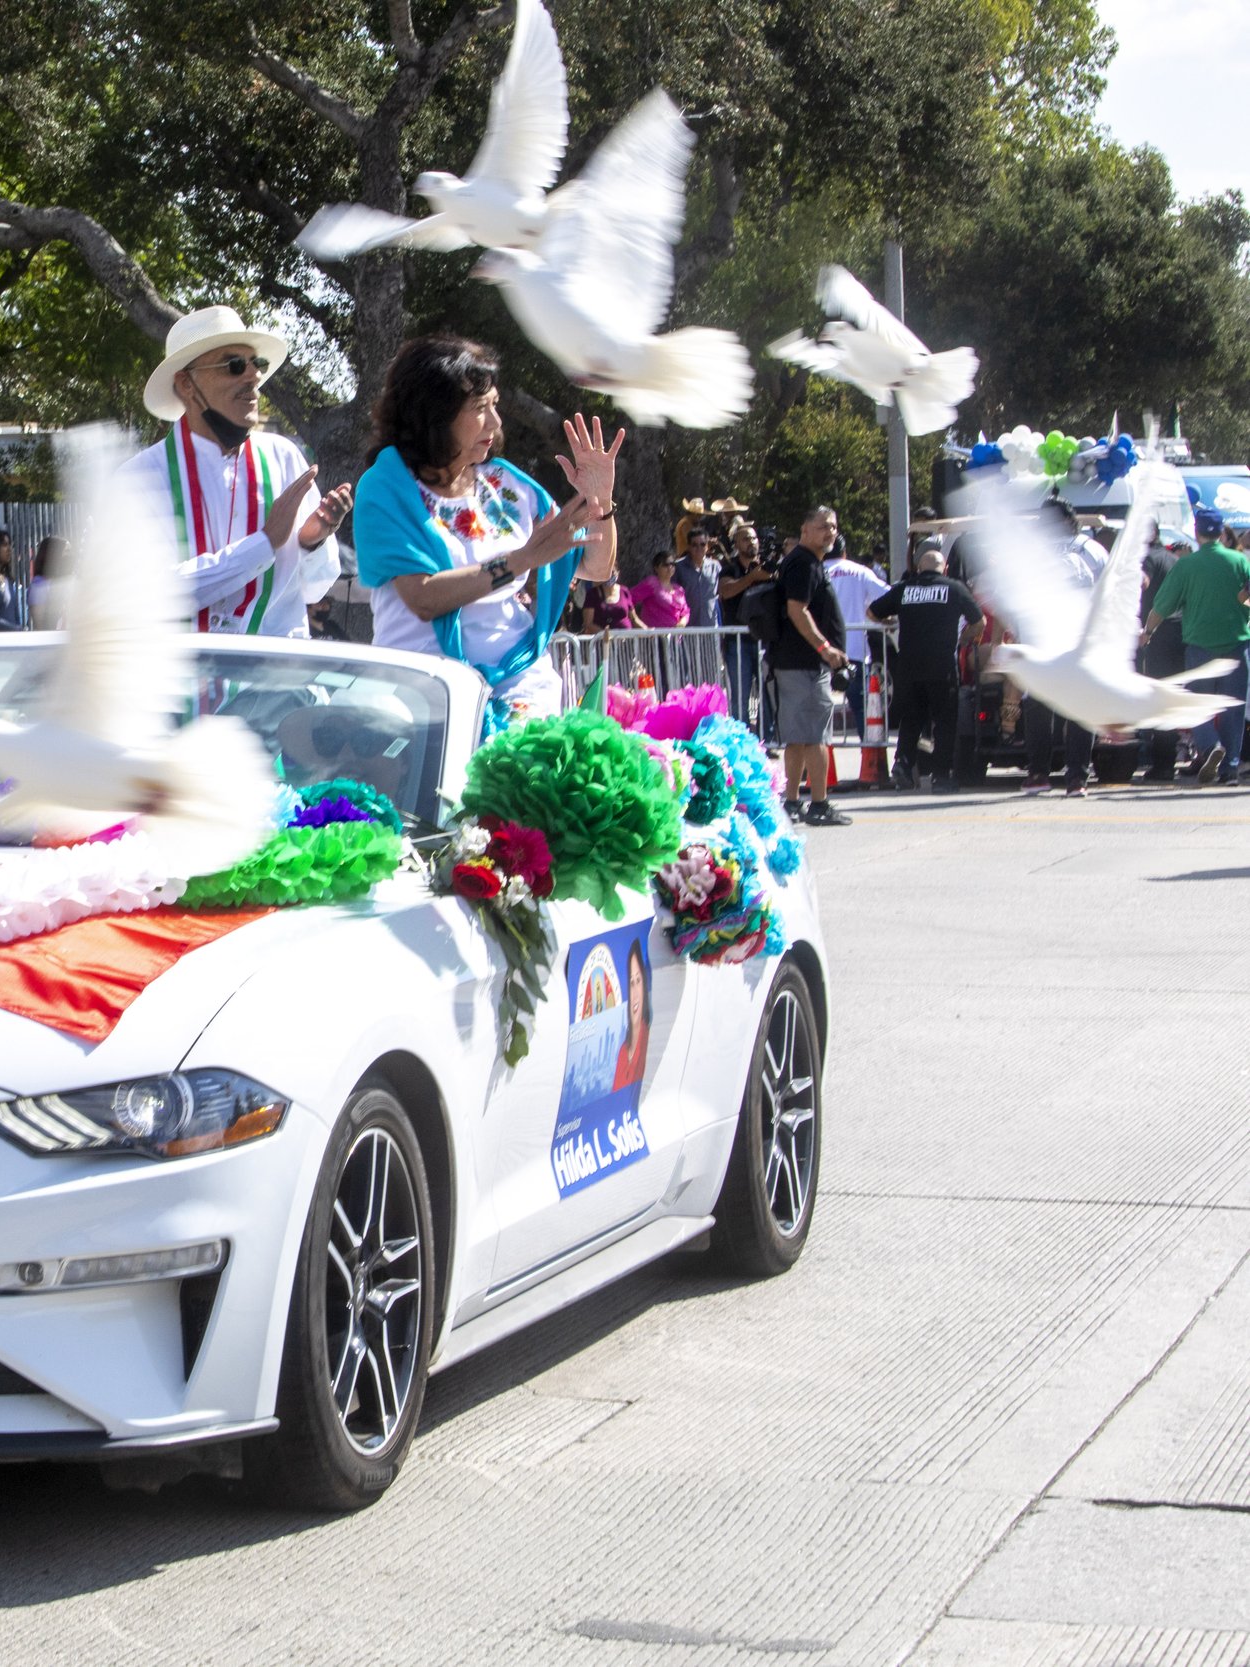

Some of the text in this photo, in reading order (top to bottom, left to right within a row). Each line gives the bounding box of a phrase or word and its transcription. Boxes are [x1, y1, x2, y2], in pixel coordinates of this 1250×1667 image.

[903, 585, 948, 602] SECURITY
[554, 1132, 598, 1190] Hilda
[608, 1110, 645, 1162] Solis
